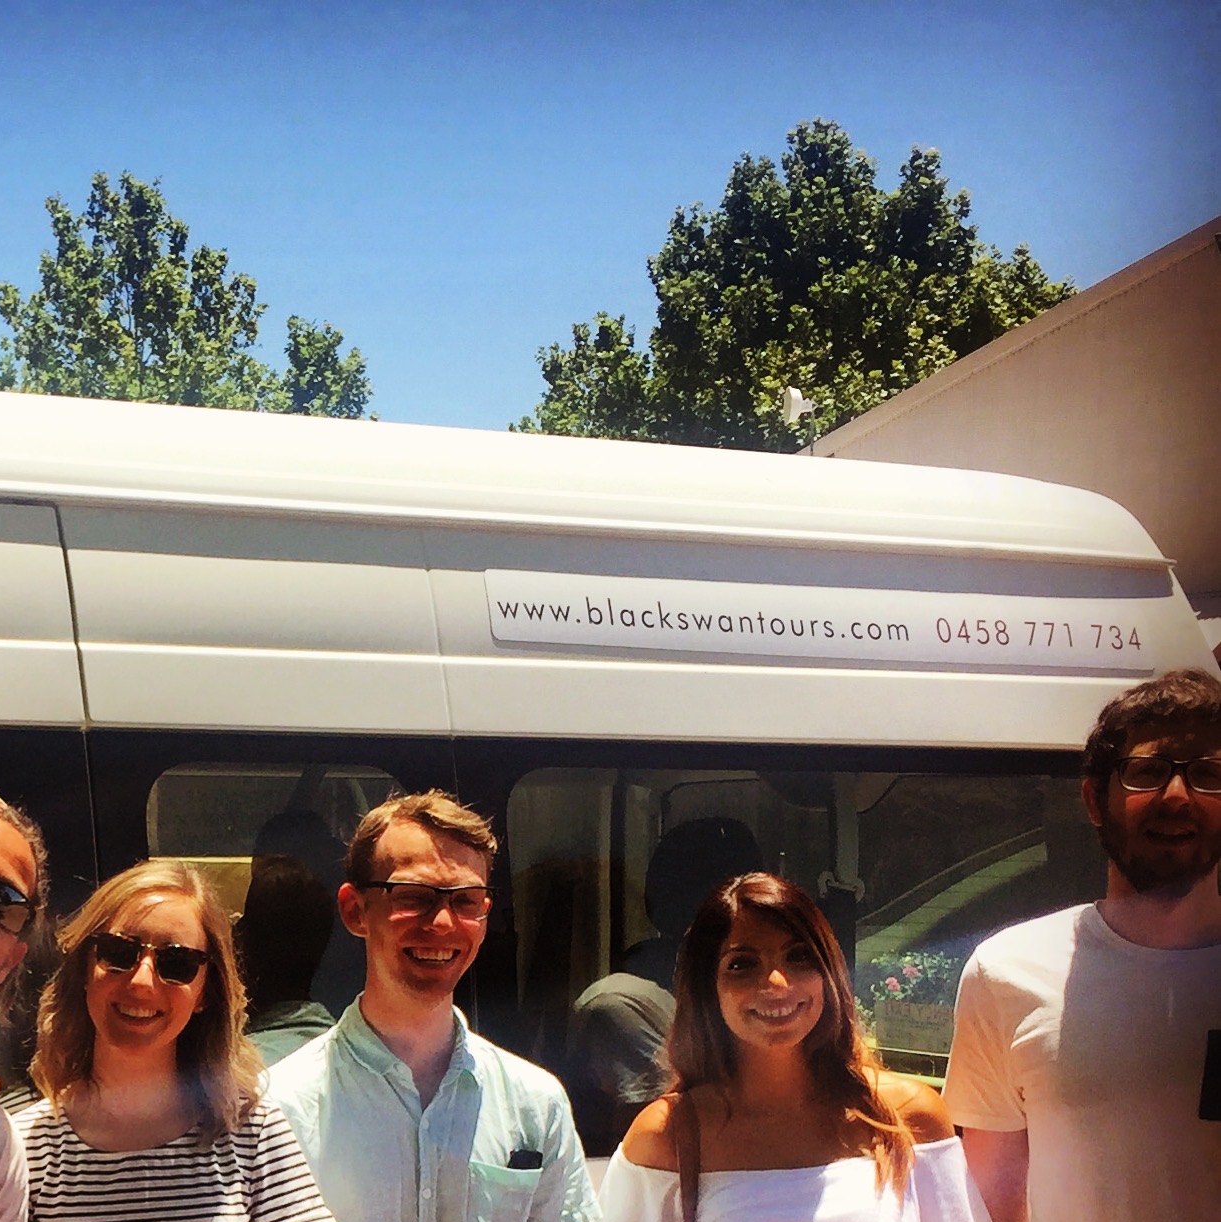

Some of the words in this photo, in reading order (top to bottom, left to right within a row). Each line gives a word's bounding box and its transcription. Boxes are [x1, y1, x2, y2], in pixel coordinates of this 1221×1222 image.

[496, 596, 910, 642] www.blackswantours.com
[936, 617, 1010, 646] 0458
[1023, 621, 1074, 648] 771
[1090, 624, 1142, 651] 734
